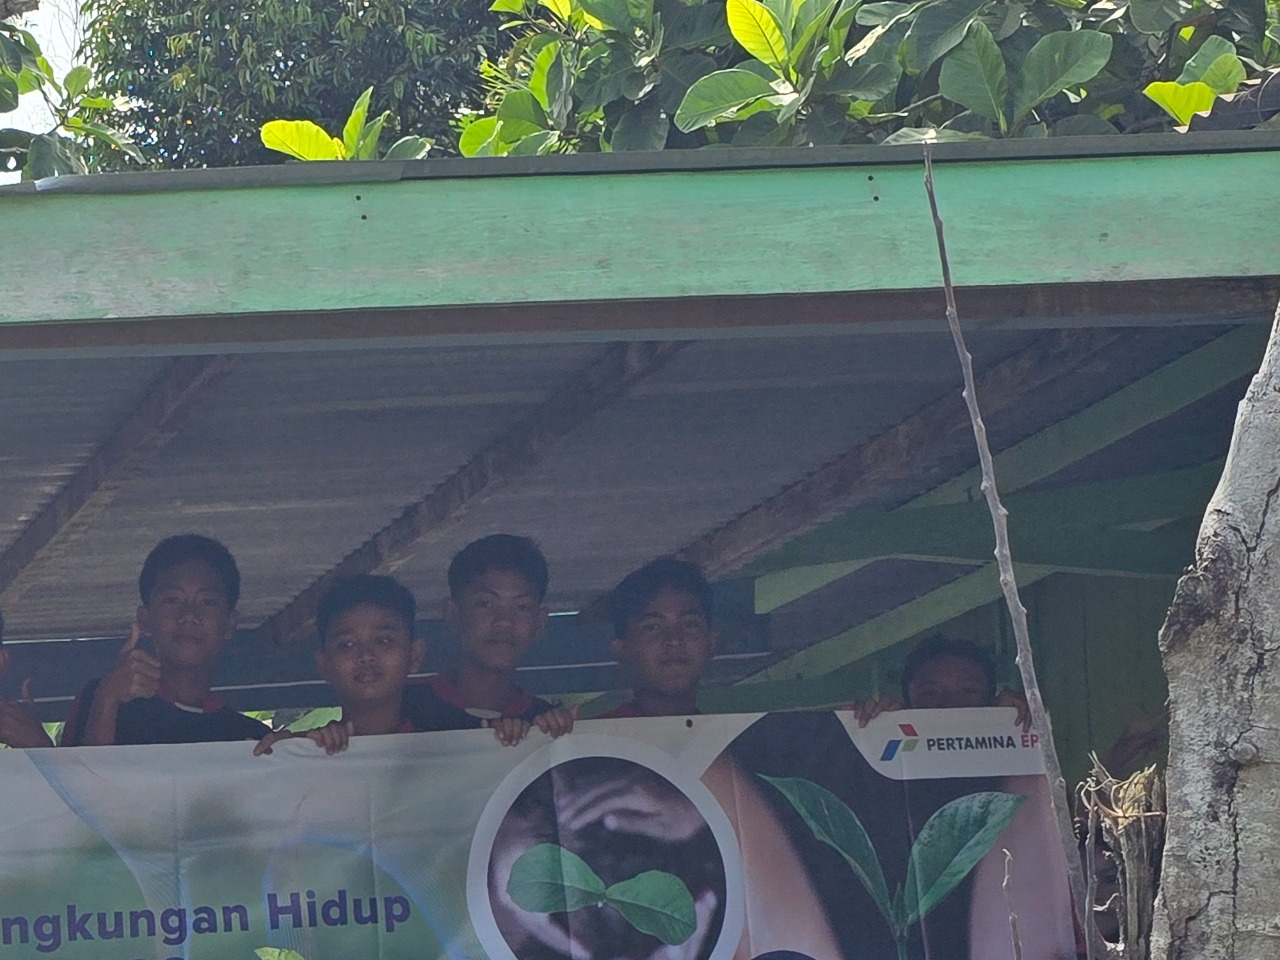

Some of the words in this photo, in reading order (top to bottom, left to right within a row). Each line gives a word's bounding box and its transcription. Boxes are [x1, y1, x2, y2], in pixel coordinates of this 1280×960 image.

[926, 736, 1016, 751] PERTAMINA
[1021, 734, 1039, 749] EP
[267, 890, 411, 933] Hidup
